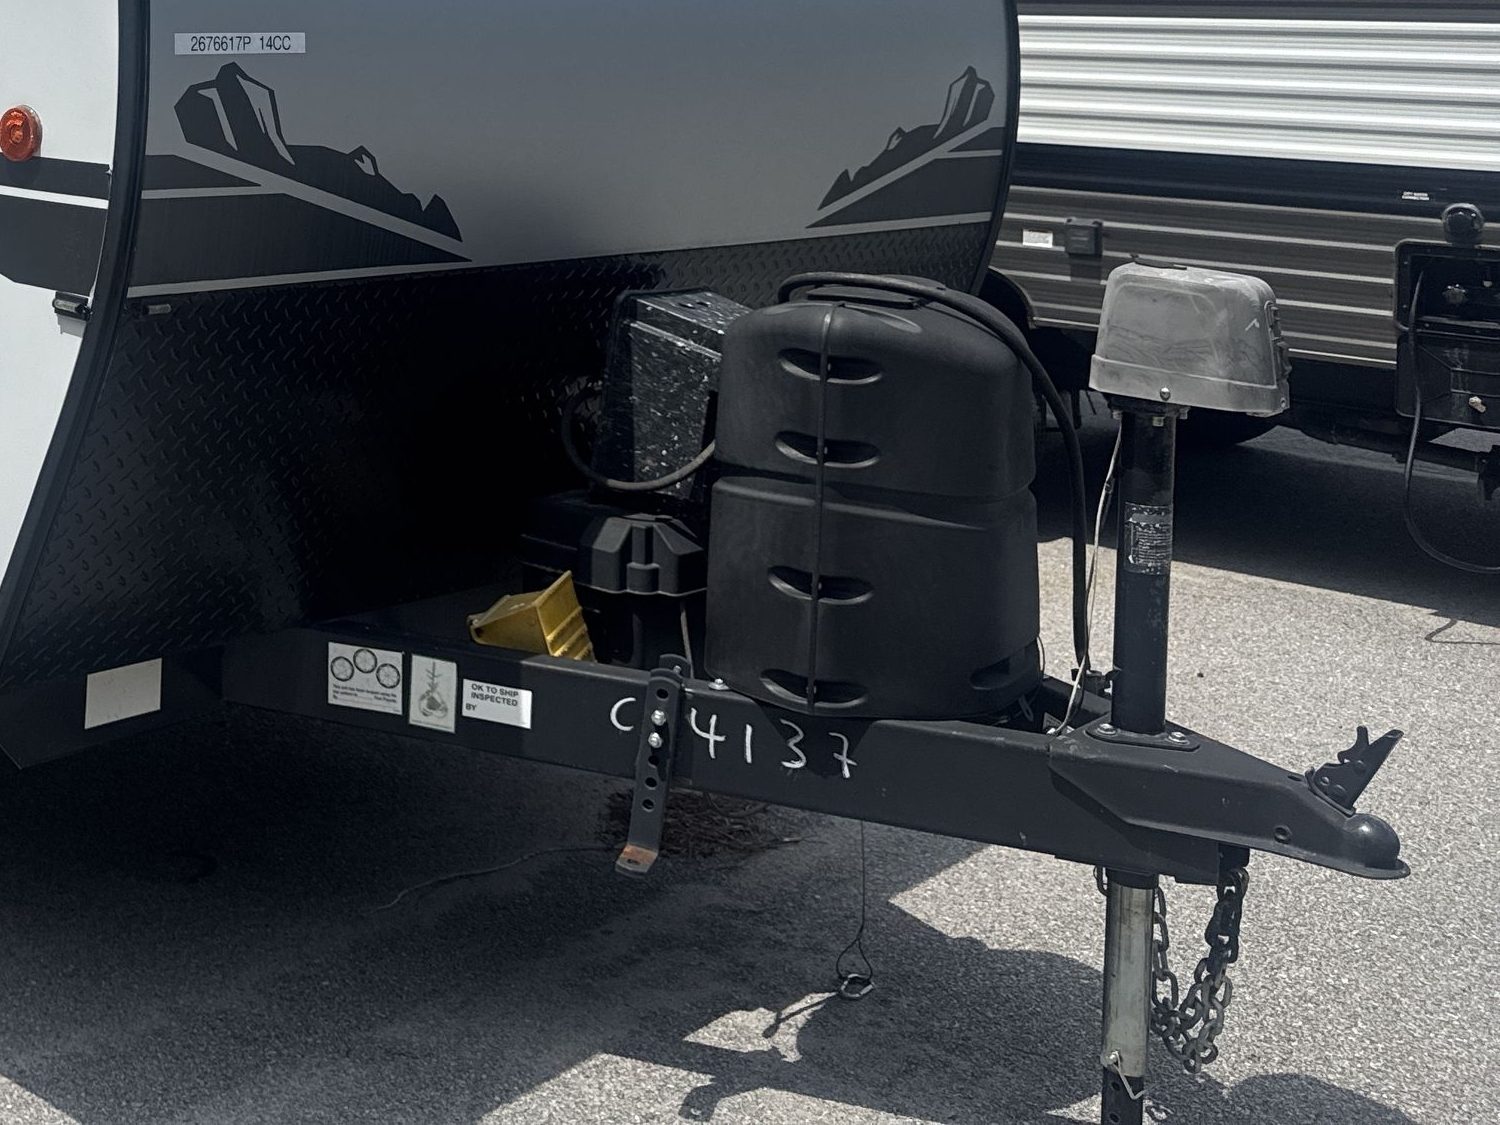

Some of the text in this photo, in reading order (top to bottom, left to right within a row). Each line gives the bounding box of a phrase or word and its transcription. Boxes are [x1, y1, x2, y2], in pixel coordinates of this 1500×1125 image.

[190, 35, 291, 52] 2676617P 14CC
[471, 683, 519, 697] OK TO SHIP
[470, 692, 518, 707] INSPECTED
[465, 703, 477, 711] BY
